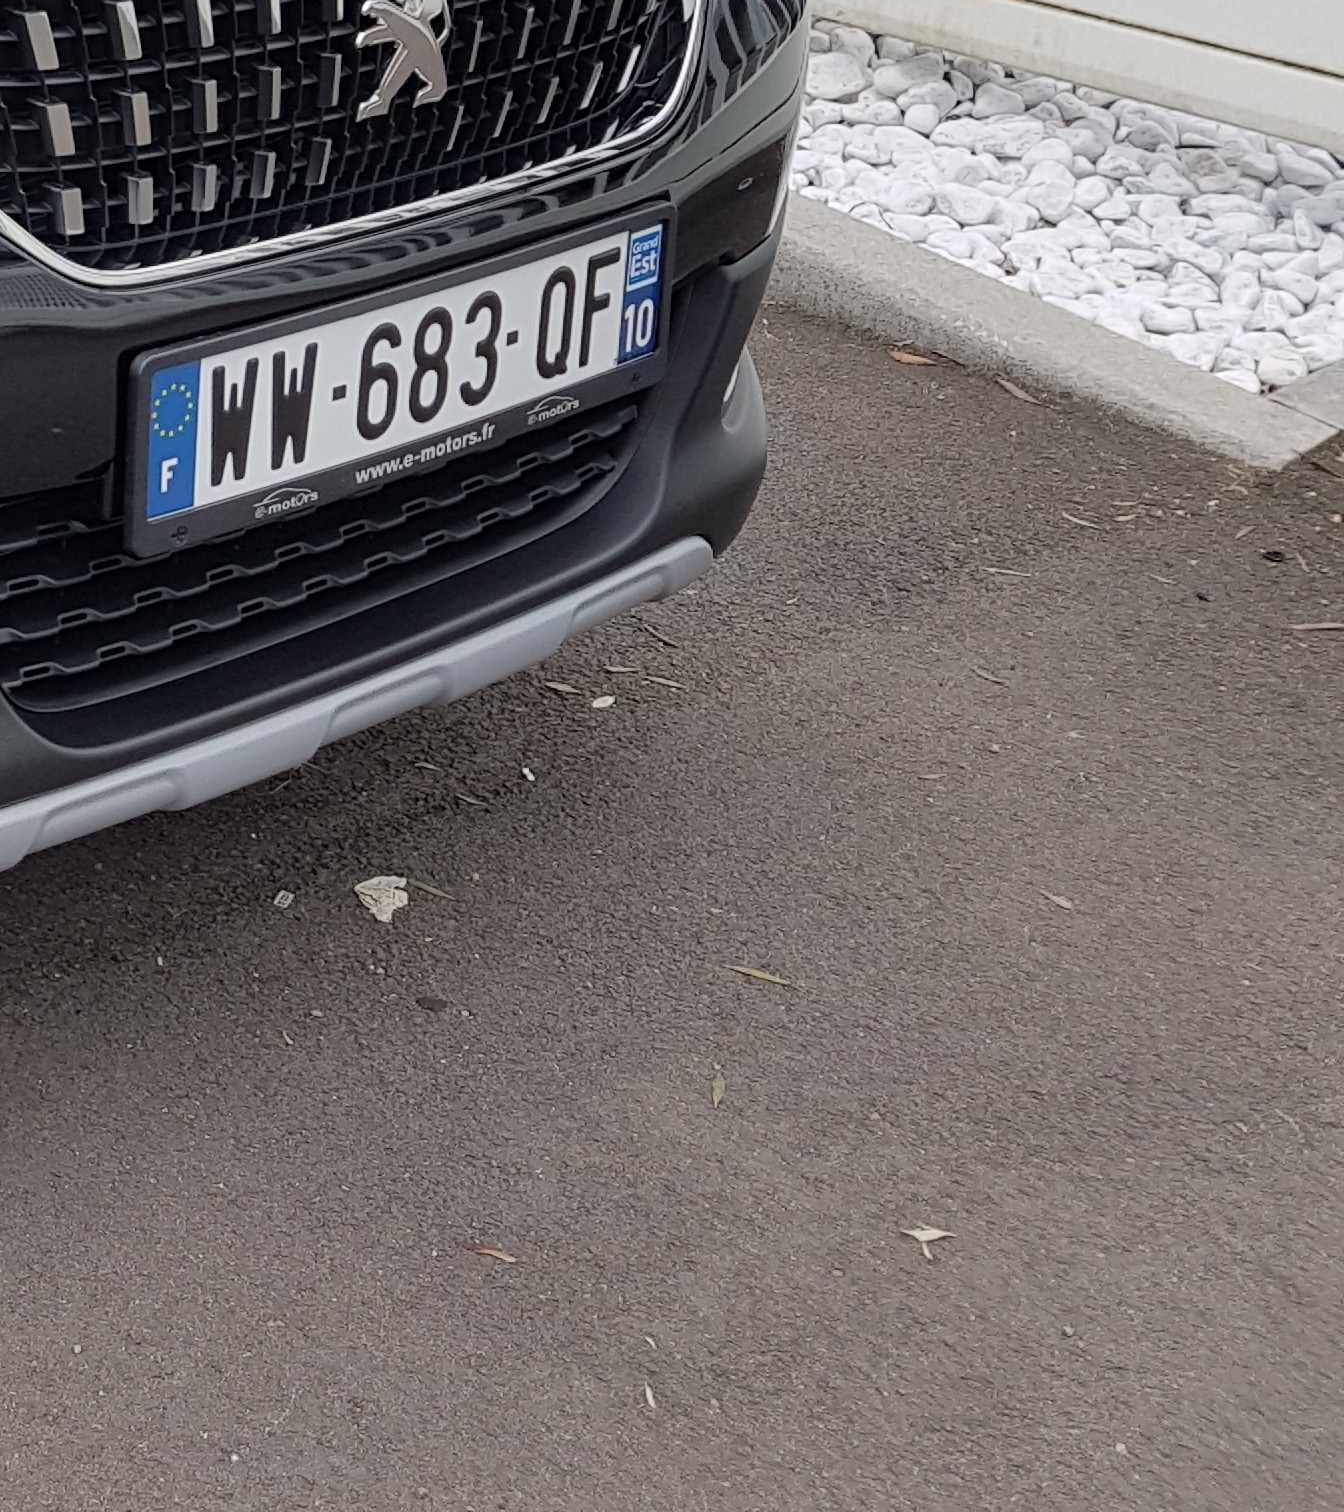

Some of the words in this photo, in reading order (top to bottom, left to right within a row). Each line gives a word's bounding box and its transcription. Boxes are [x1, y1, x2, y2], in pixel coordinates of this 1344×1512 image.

[630, 249, 657, 278] Est
[632, 235, 658, 254] Grand
[624, 298, 654, 353] 10
[211, 246, 621, 487] WW-683-QF
[160, 457, 179, 493] F
[355, 422, 496, 484] www.e-motors.fr
